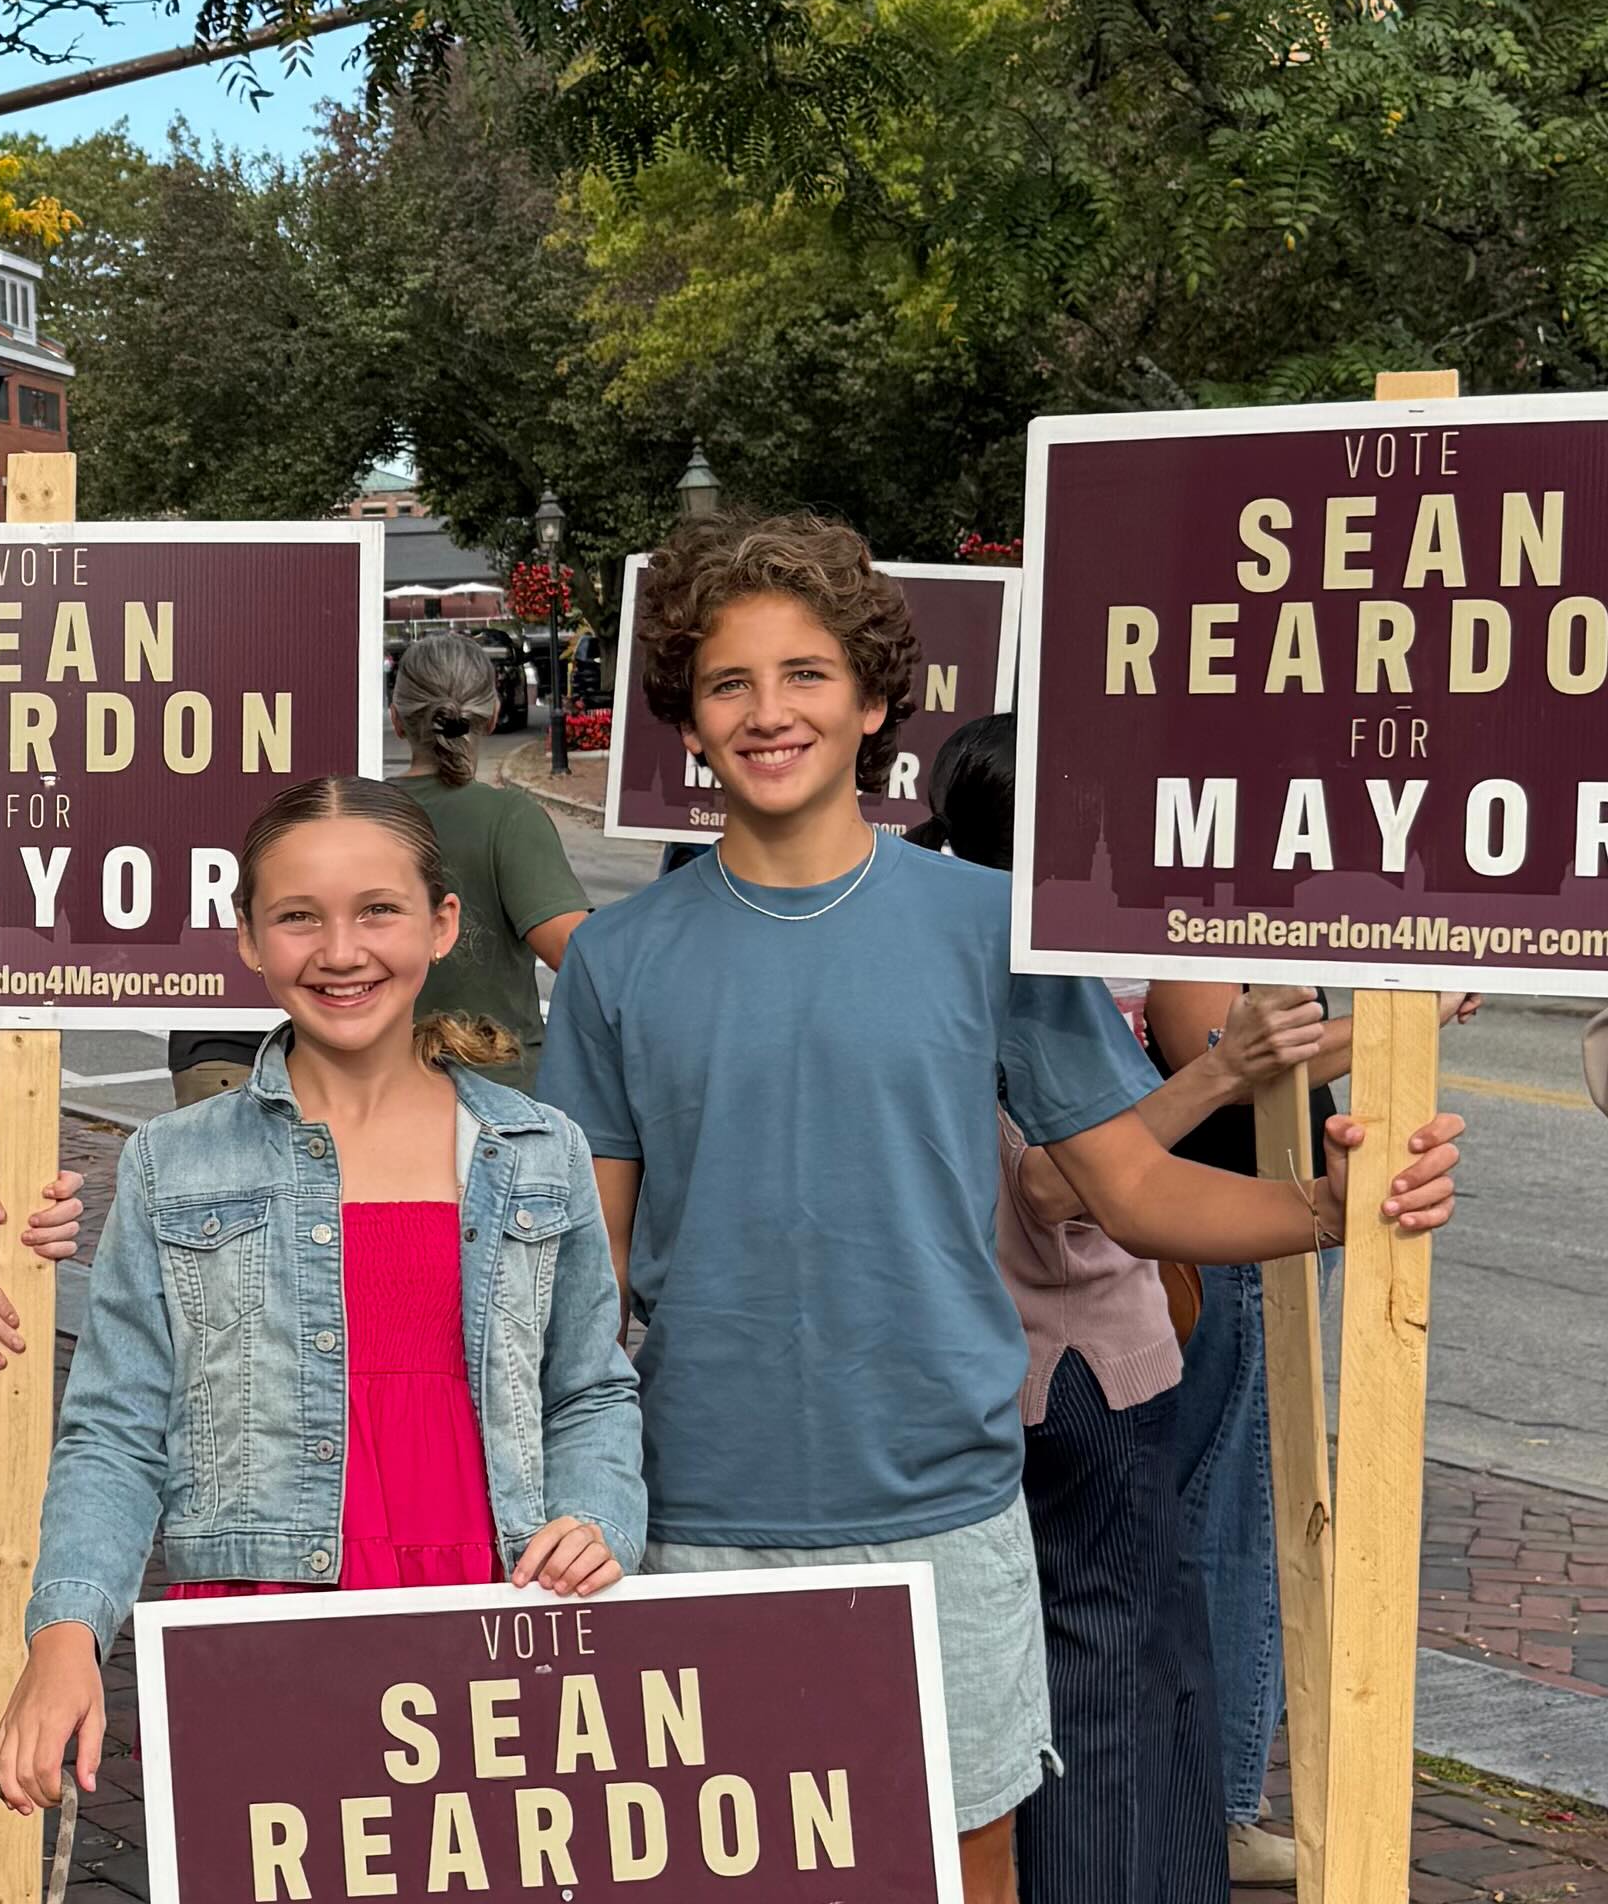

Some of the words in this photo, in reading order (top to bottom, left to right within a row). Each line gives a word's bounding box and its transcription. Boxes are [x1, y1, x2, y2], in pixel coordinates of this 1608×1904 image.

[1345, 431, 1460, 478] VOTE
[1237, 490, 1565, 593] SEAN
[1351, 718, 1428, 758] FOR
[7, 793, 70, 829] FOR
[1167, 909, 1608, 961] SeanReardon4Mayor.com
[480, 1609, 595, 1661] VOTE
[380, 1667, 706, 1784] SEAN
[248, 1768, 856, 1903] REARDON
